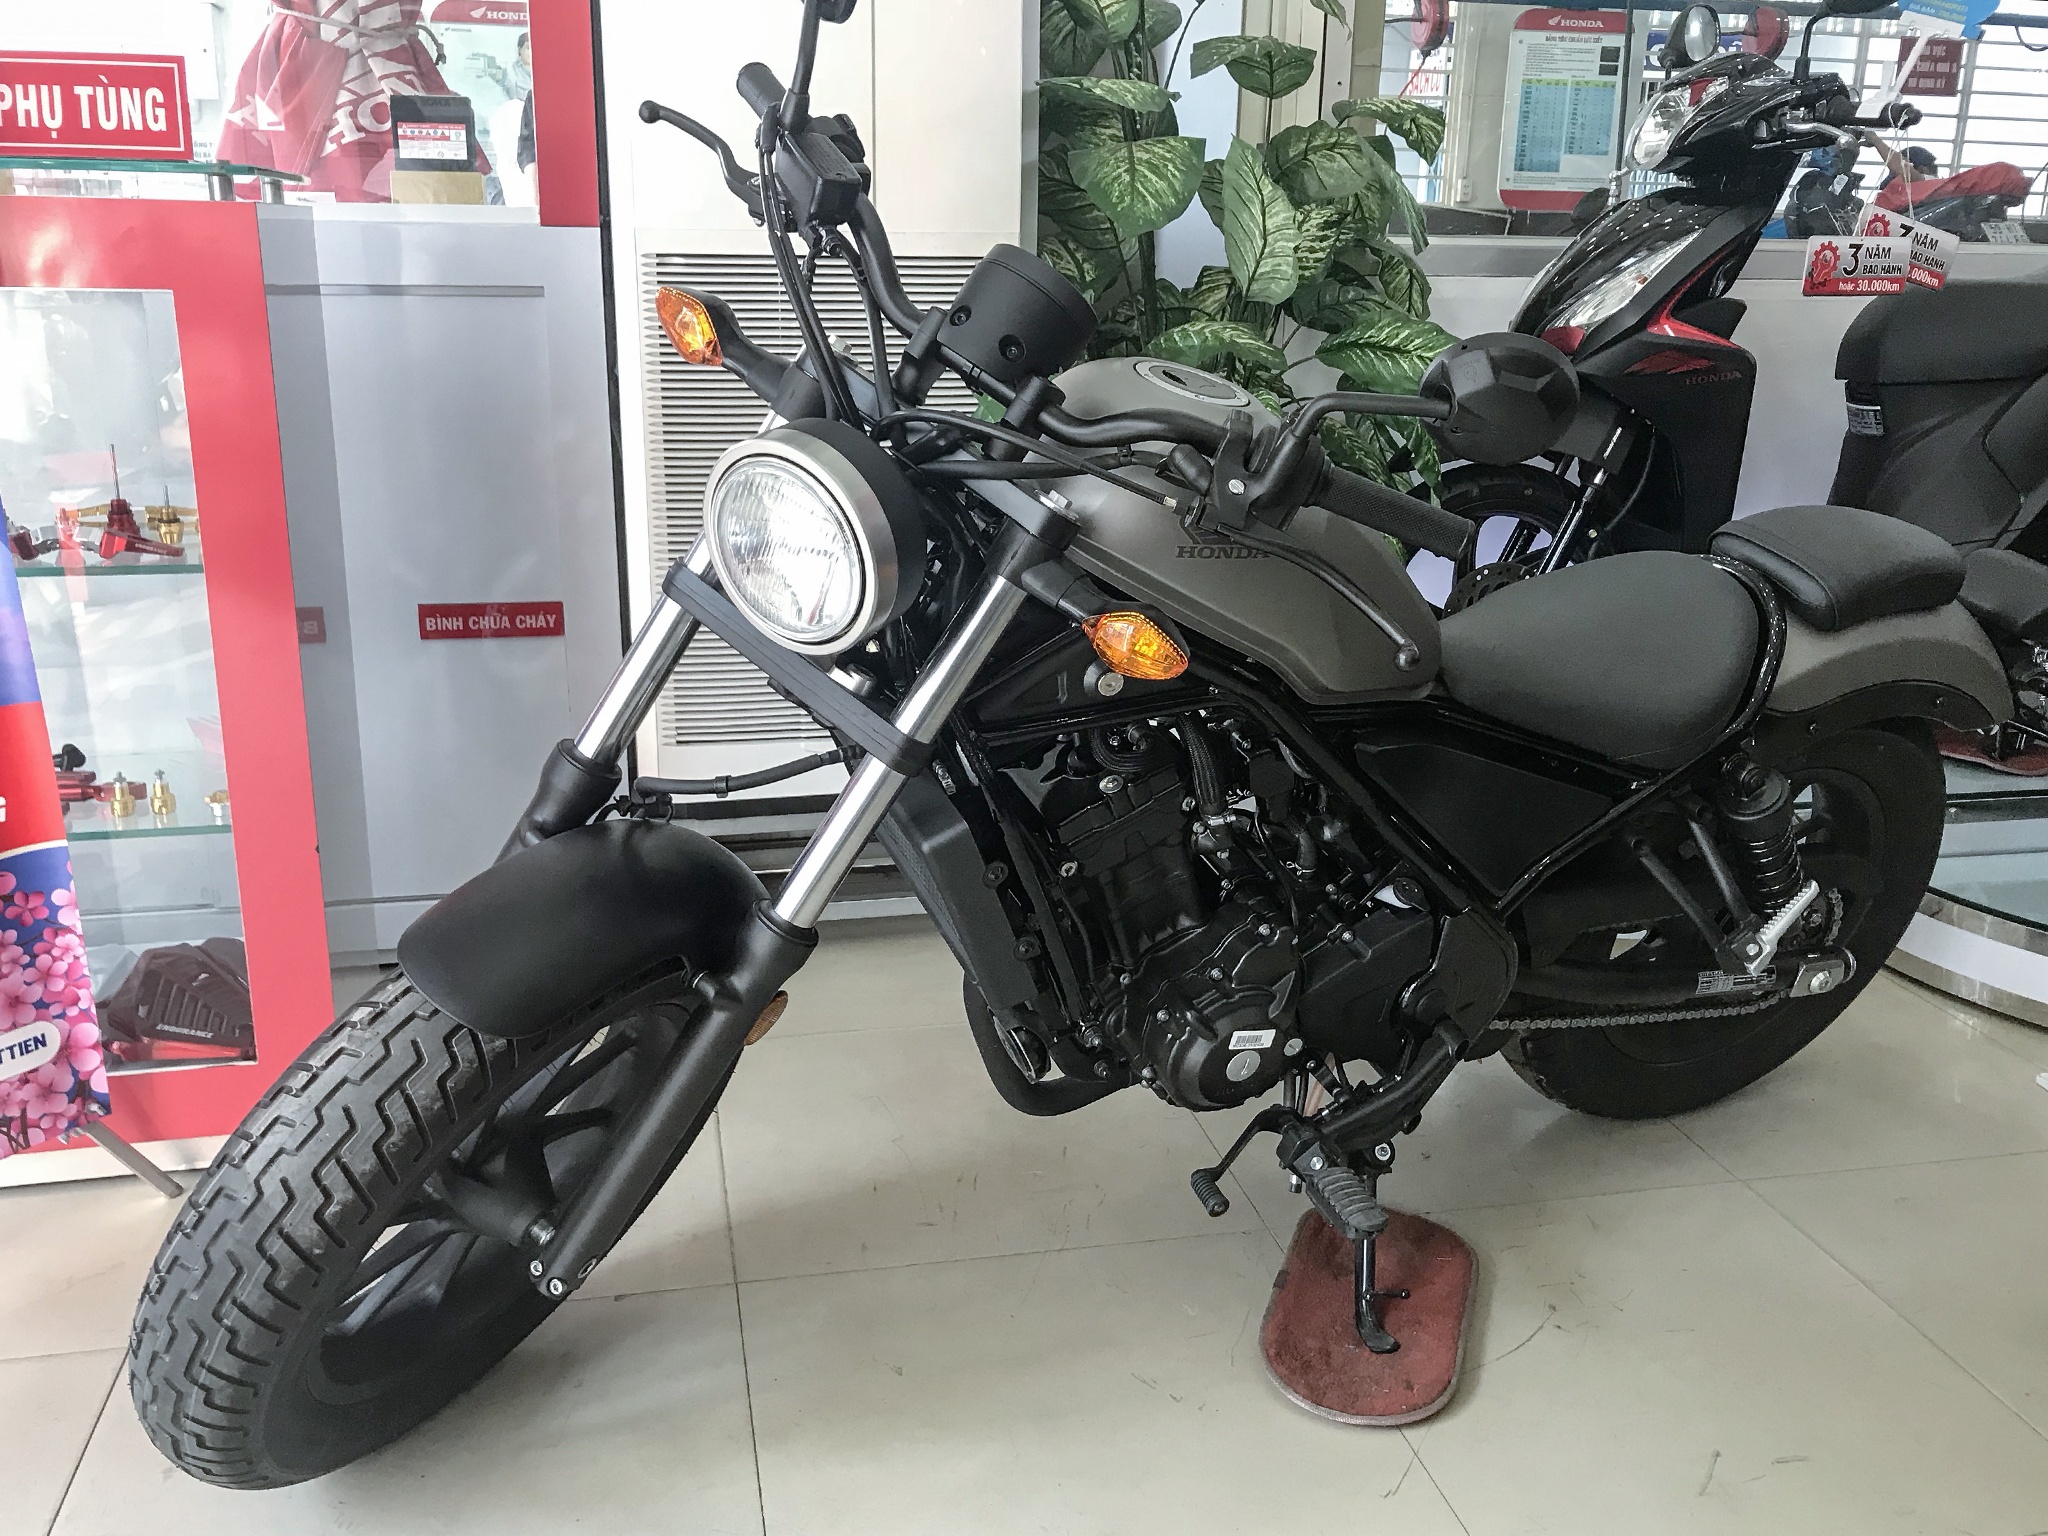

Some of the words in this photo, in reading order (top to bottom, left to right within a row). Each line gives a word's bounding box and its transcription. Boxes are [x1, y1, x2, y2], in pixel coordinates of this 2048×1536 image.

[1560, 19, 1604, 28] HONDA
[73, 74, 167, 132] TÙNG
[1912, 232, 1939, 251] NĂM
[1843, 243, 1864, 276] 3
[1864, 244, 1892, 259] NĂM
[1923, 255, 1946, 271] HÀNH
[1862, 261, 1878, 275] BẢO
[1880, 261, 1902, 275] HÀNH
[1838, 281, 1855, 292] hoặc
[1857, 280, 1900, 291] 30.000km
[1685, 371, 1742, 385] HONDA
[425, 613, 464, 631] BÌNH
[468, 612, 511, 630] CHỮA
[515, 610, 557, 628] CHÁY
